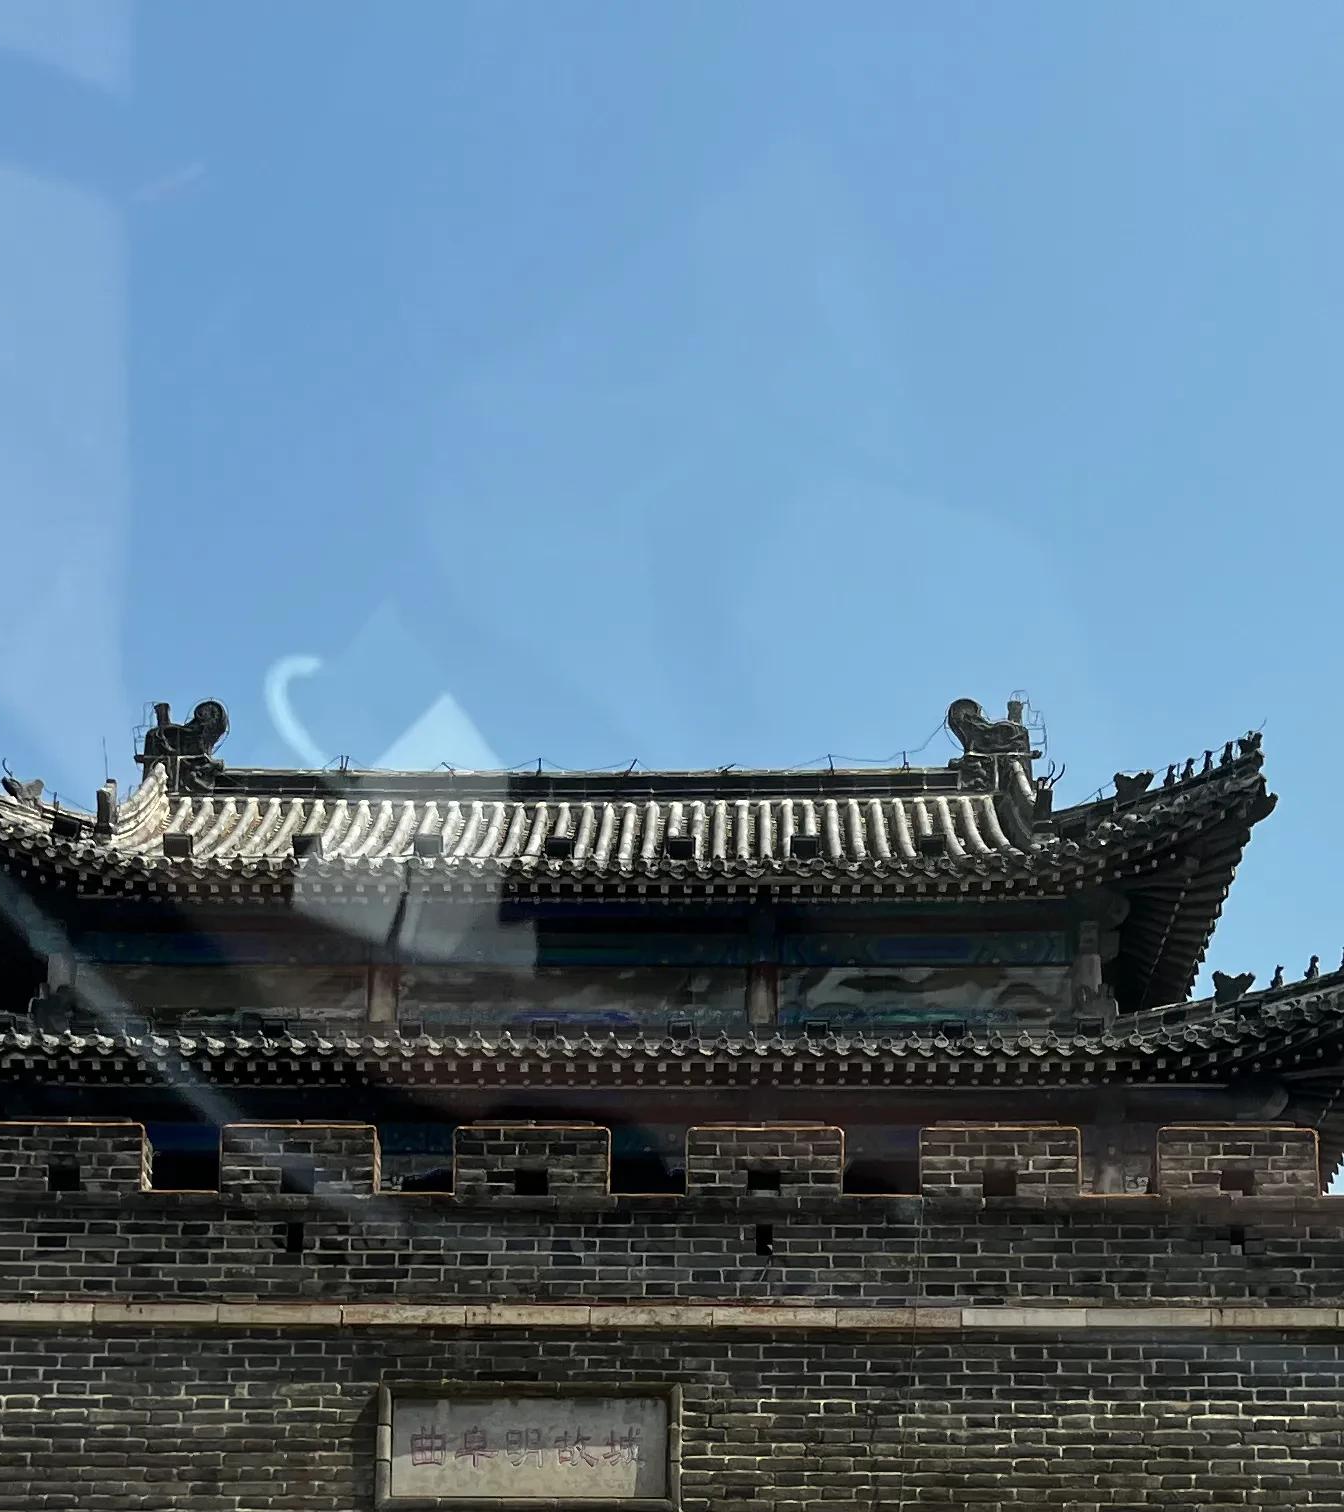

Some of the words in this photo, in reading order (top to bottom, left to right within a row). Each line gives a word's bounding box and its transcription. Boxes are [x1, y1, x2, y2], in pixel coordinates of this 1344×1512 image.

[410, 1425, 646, 1469] 曲阜明故城
